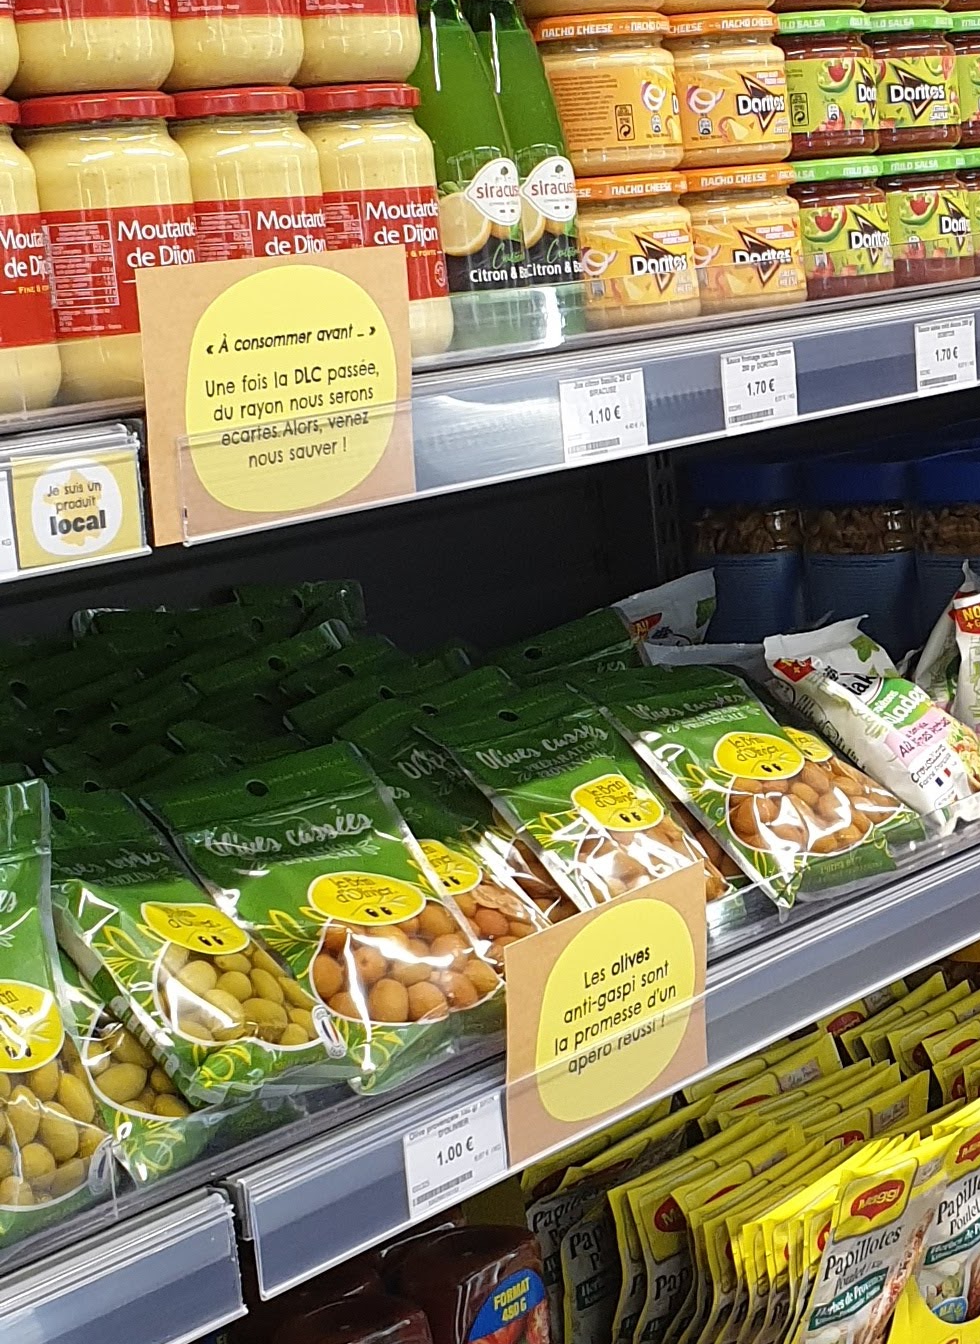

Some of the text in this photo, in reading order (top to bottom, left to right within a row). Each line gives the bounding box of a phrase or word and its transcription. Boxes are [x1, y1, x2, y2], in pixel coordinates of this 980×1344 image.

[577, 23, 614, 37] CHEESE
[739, 94, 785, 117] Doritos
[366, 202, 438, 220] Moutarde
[374, 226, 437, 245] de Dijon
[469, 268, 518, 284] Citron &
[218, 323, 353, 354] À consommer avant
[935, 348, 951, 362] 1.70
[205, 359, 380, 398] Une fois la DLC passée,
[747, 381, 765, 397] 1.70
[214, 387, 374, 421] du rayon nous serons
[589, 406, 611, 423] 1.10
[328, 411, 369, 430] venez
[249, 441, 338, 468] nous sauver
[47, 482, 102, 497] Je suis un
[56, 496, 96, 515] produit
[50, 510, 106, 536] local
[584, 947, 650, 989] Les olives
[564, 960, 669, 1023] anti-gaspi sont
[555, 985, 676, 1056] la promesse d'un
[437, 1136, 475, 1167] 1.00 €
[855, 1183, 902, 1212] Maggi
[824, 1225, 903, 1283] Papillotes
